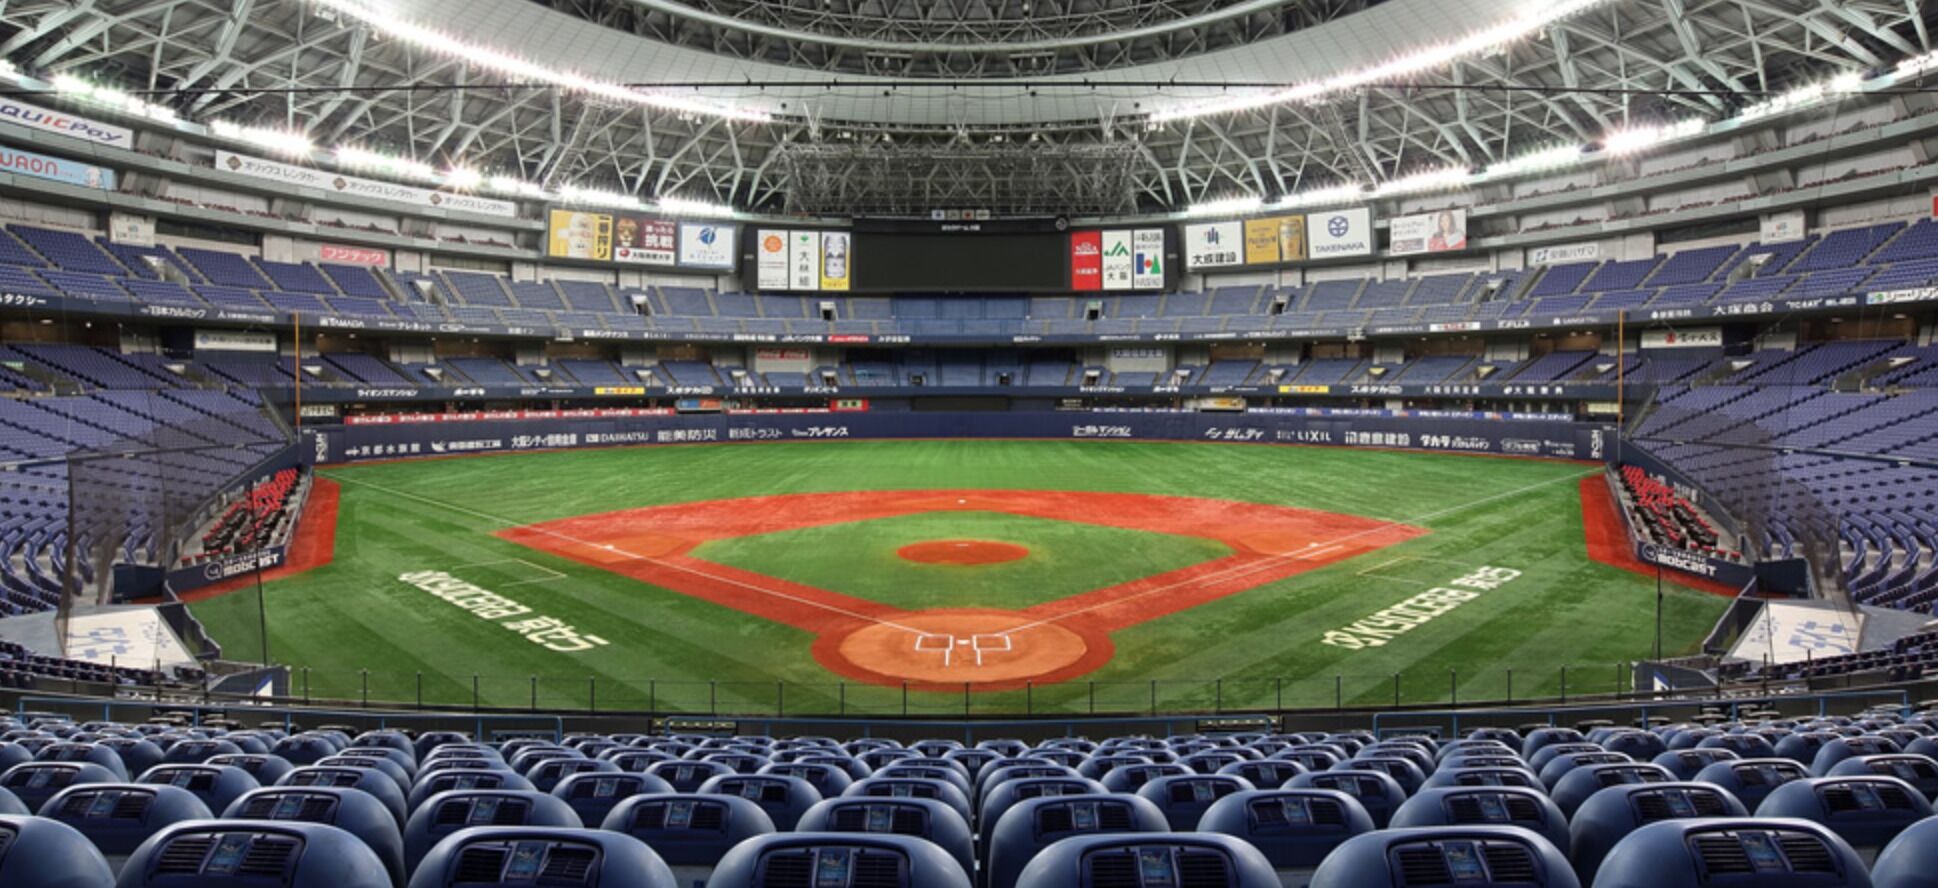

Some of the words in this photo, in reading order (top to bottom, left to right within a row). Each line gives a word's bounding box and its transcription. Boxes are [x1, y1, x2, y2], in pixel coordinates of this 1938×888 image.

[1315, 241, 1366, 253] TAKENAKA
[325, 247, 382, 264] フジテック
[1193, 251, 1237, 265] 大成建設
[1713, 302, 1774, 316] 大塚商会
[512, 433, 577, 448] 大阪シティ信用金庫
[601, 432, 649, 442] DAIHATSU
[658, 428, 717, 442] 能美防災
[1297, 431, 1332, 442] LIXIL
